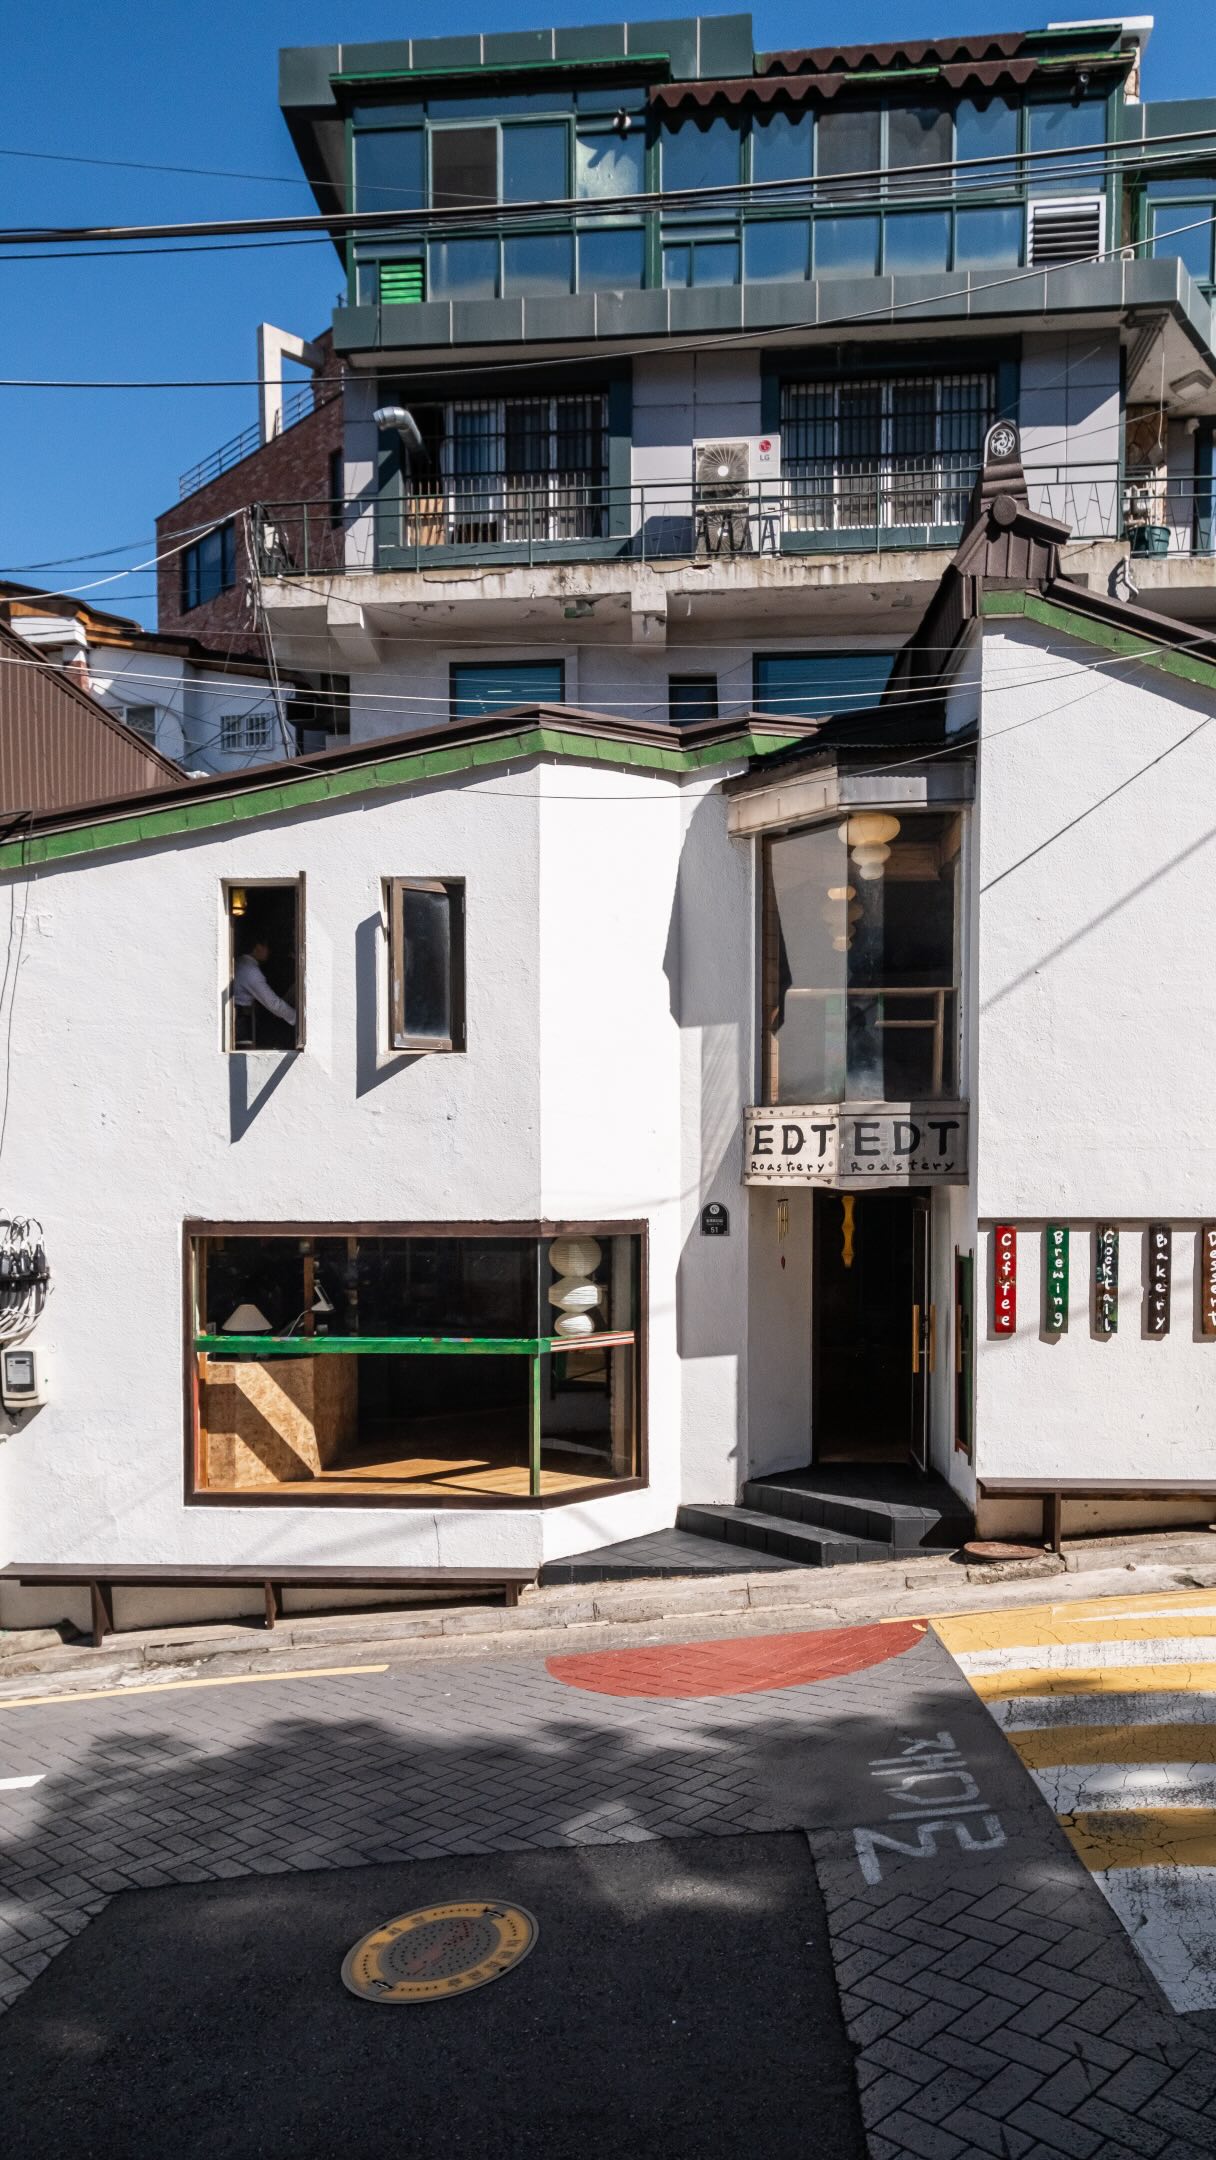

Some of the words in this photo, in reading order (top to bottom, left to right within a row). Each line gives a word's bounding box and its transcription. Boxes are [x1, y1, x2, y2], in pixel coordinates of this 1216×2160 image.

[751, 1161, 825, 1173] Roastery
[752, 1124, 836, 1157] EDT
[850, 1159, 955, 1173] Roastery
[853, 1120, 960, 1156] EDT
[1001, 1233, 1012, 1326] Coffee
[1053, 1231, 1064, 1328] Brewing
[1102, 1231, 1115, 1332] Cocktail
[1155, 1233, 1168, 1330] Bakery
